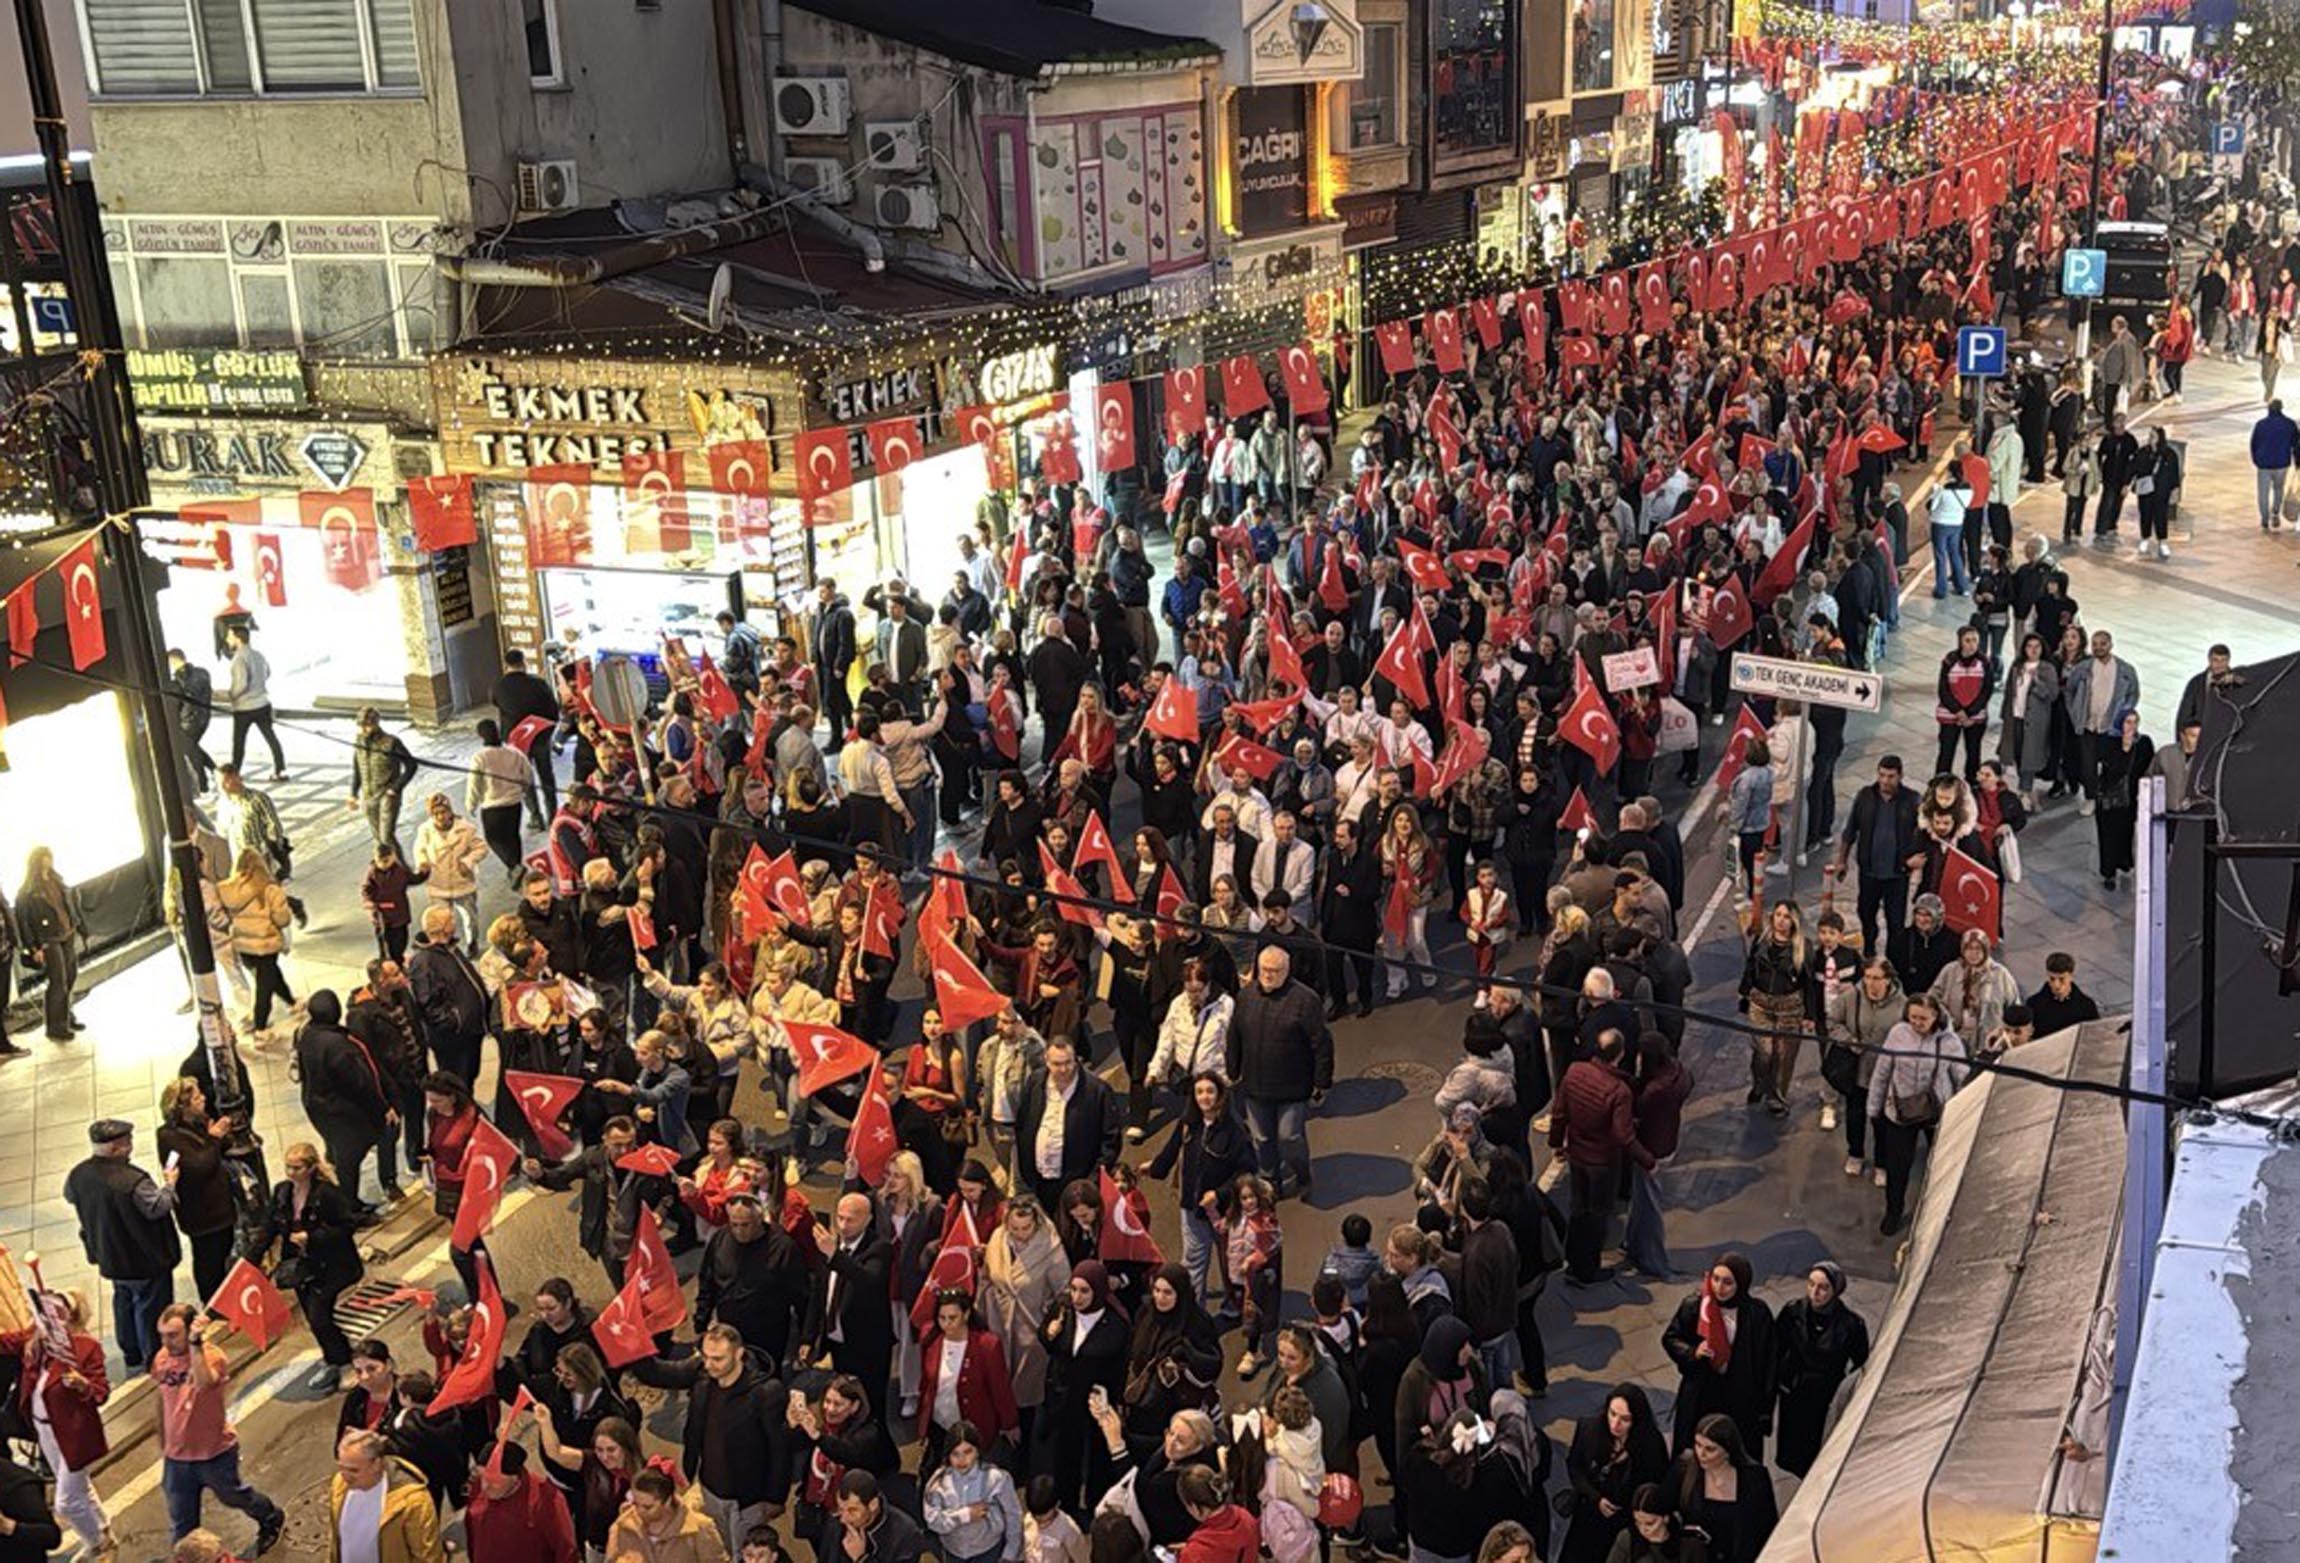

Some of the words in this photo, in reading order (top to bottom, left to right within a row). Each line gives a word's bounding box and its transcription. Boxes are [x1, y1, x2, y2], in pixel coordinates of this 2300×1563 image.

[2219, 126, 2237, 149] P
[2068, 254, 2093, 290] P
[127, 350, 198, 381] ÜMÜŞ
[1968, 331, 1995, 371] P
[485, 385, 646, 424] EKMEK
[836, 366, 921, 421] EKMEK
[473, 432, 669, 471] TEKNESİ
[1755, 665, 1774, 682] TEK
[1776, 668, 1801, 688] GENÇ
[1804, 673, 1849, 694] AKADEMİ
